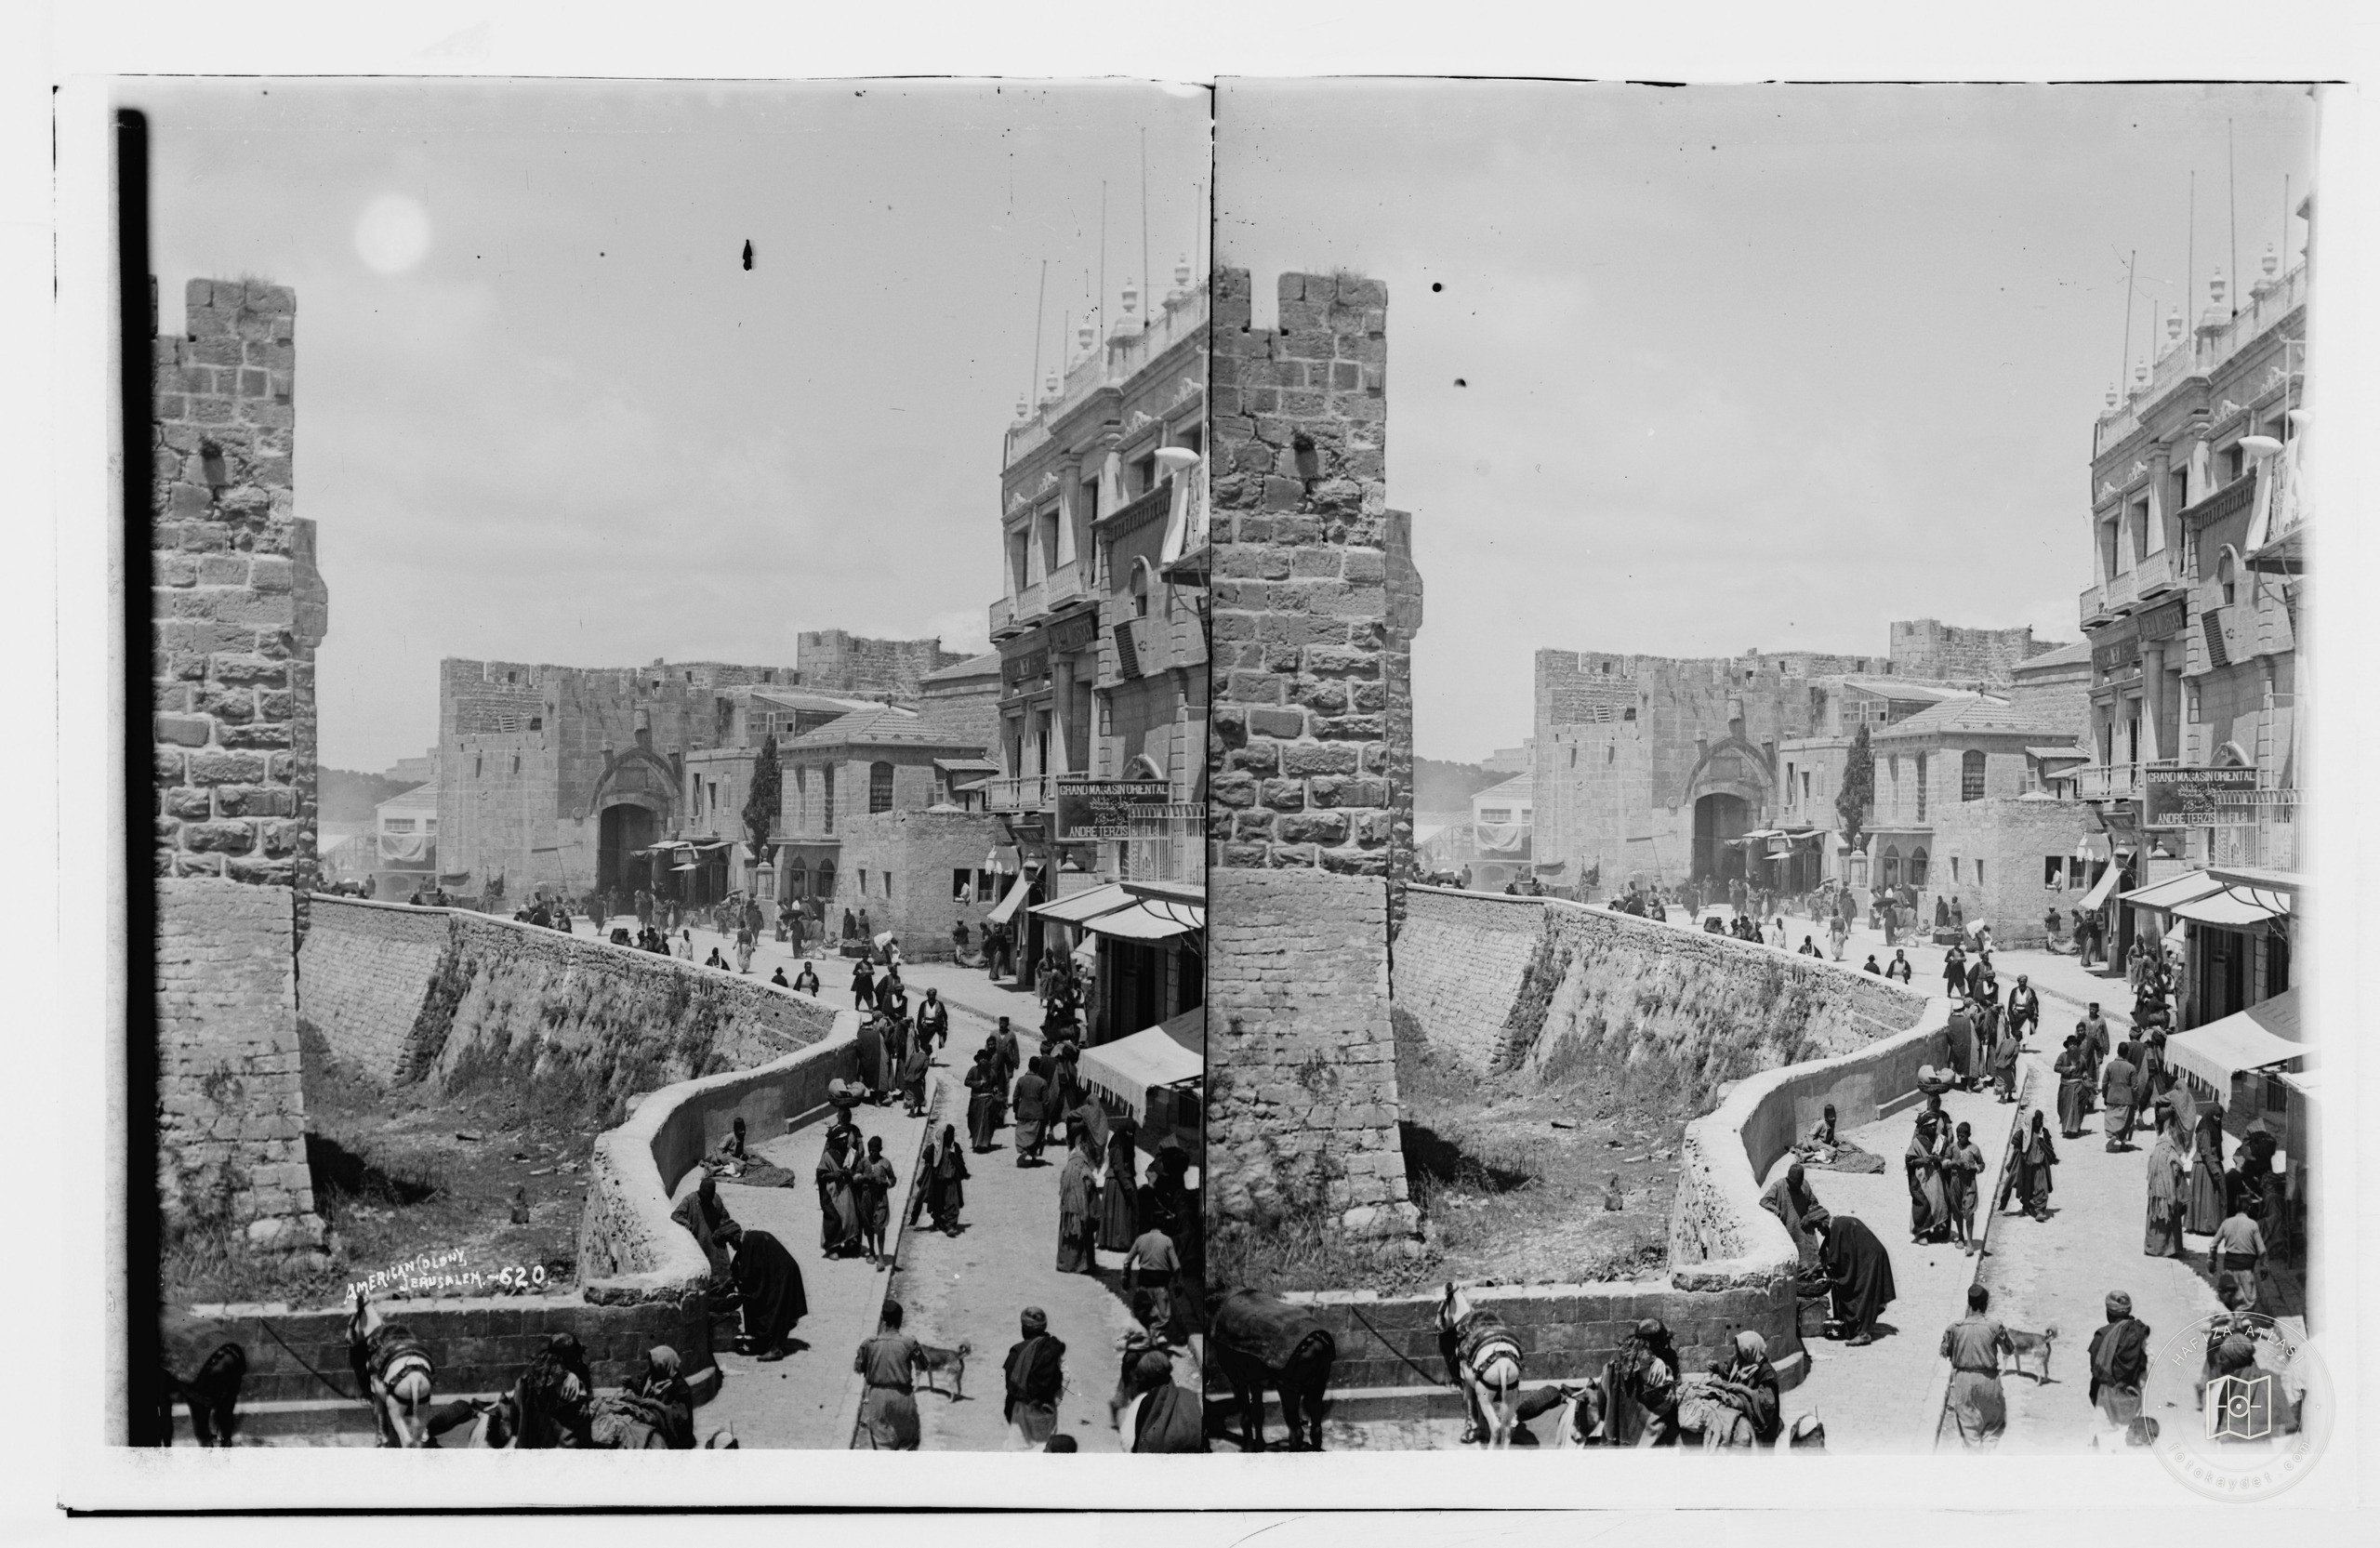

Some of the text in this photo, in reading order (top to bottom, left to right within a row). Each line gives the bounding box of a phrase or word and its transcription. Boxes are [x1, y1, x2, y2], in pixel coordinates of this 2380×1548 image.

[2148, 771, 2256, 783] GRAND MAGASIN ORIENTAL
[1059, 784, 1169, 795] GRAND MAGASIN ORIENTAL
[2187, 813, 2216, 824] TERZIS
[1099, 826, 1129, 837] TERZIS
